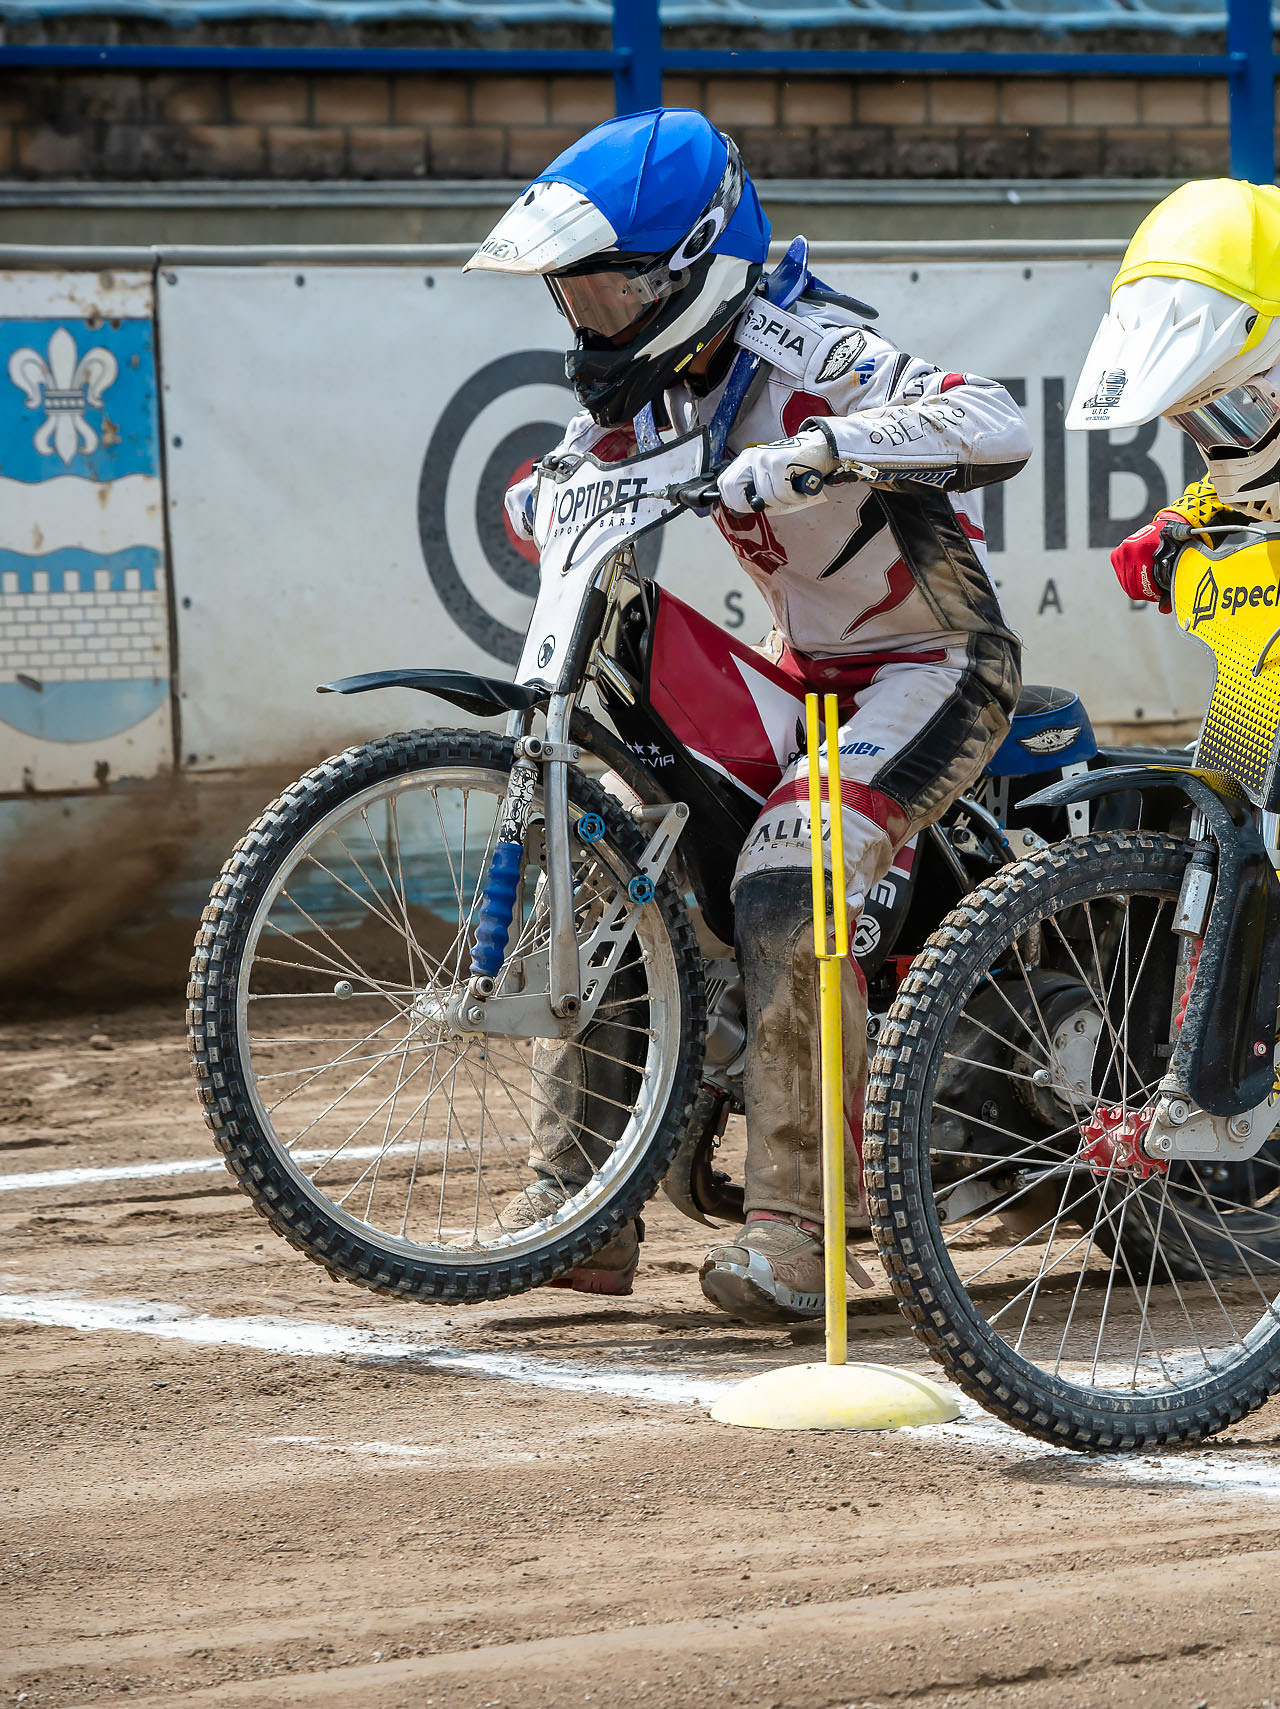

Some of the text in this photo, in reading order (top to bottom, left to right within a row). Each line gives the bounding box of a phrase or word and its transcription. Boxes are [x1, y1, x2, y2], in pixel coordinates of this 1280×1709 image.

[745, 309, 805, 356] SOFIA
[558, 478, 648, 524] OPTIBET
[554, 517, 636, 538] SPOR BĀRS
[640, 754, 675, 769] TVIA
